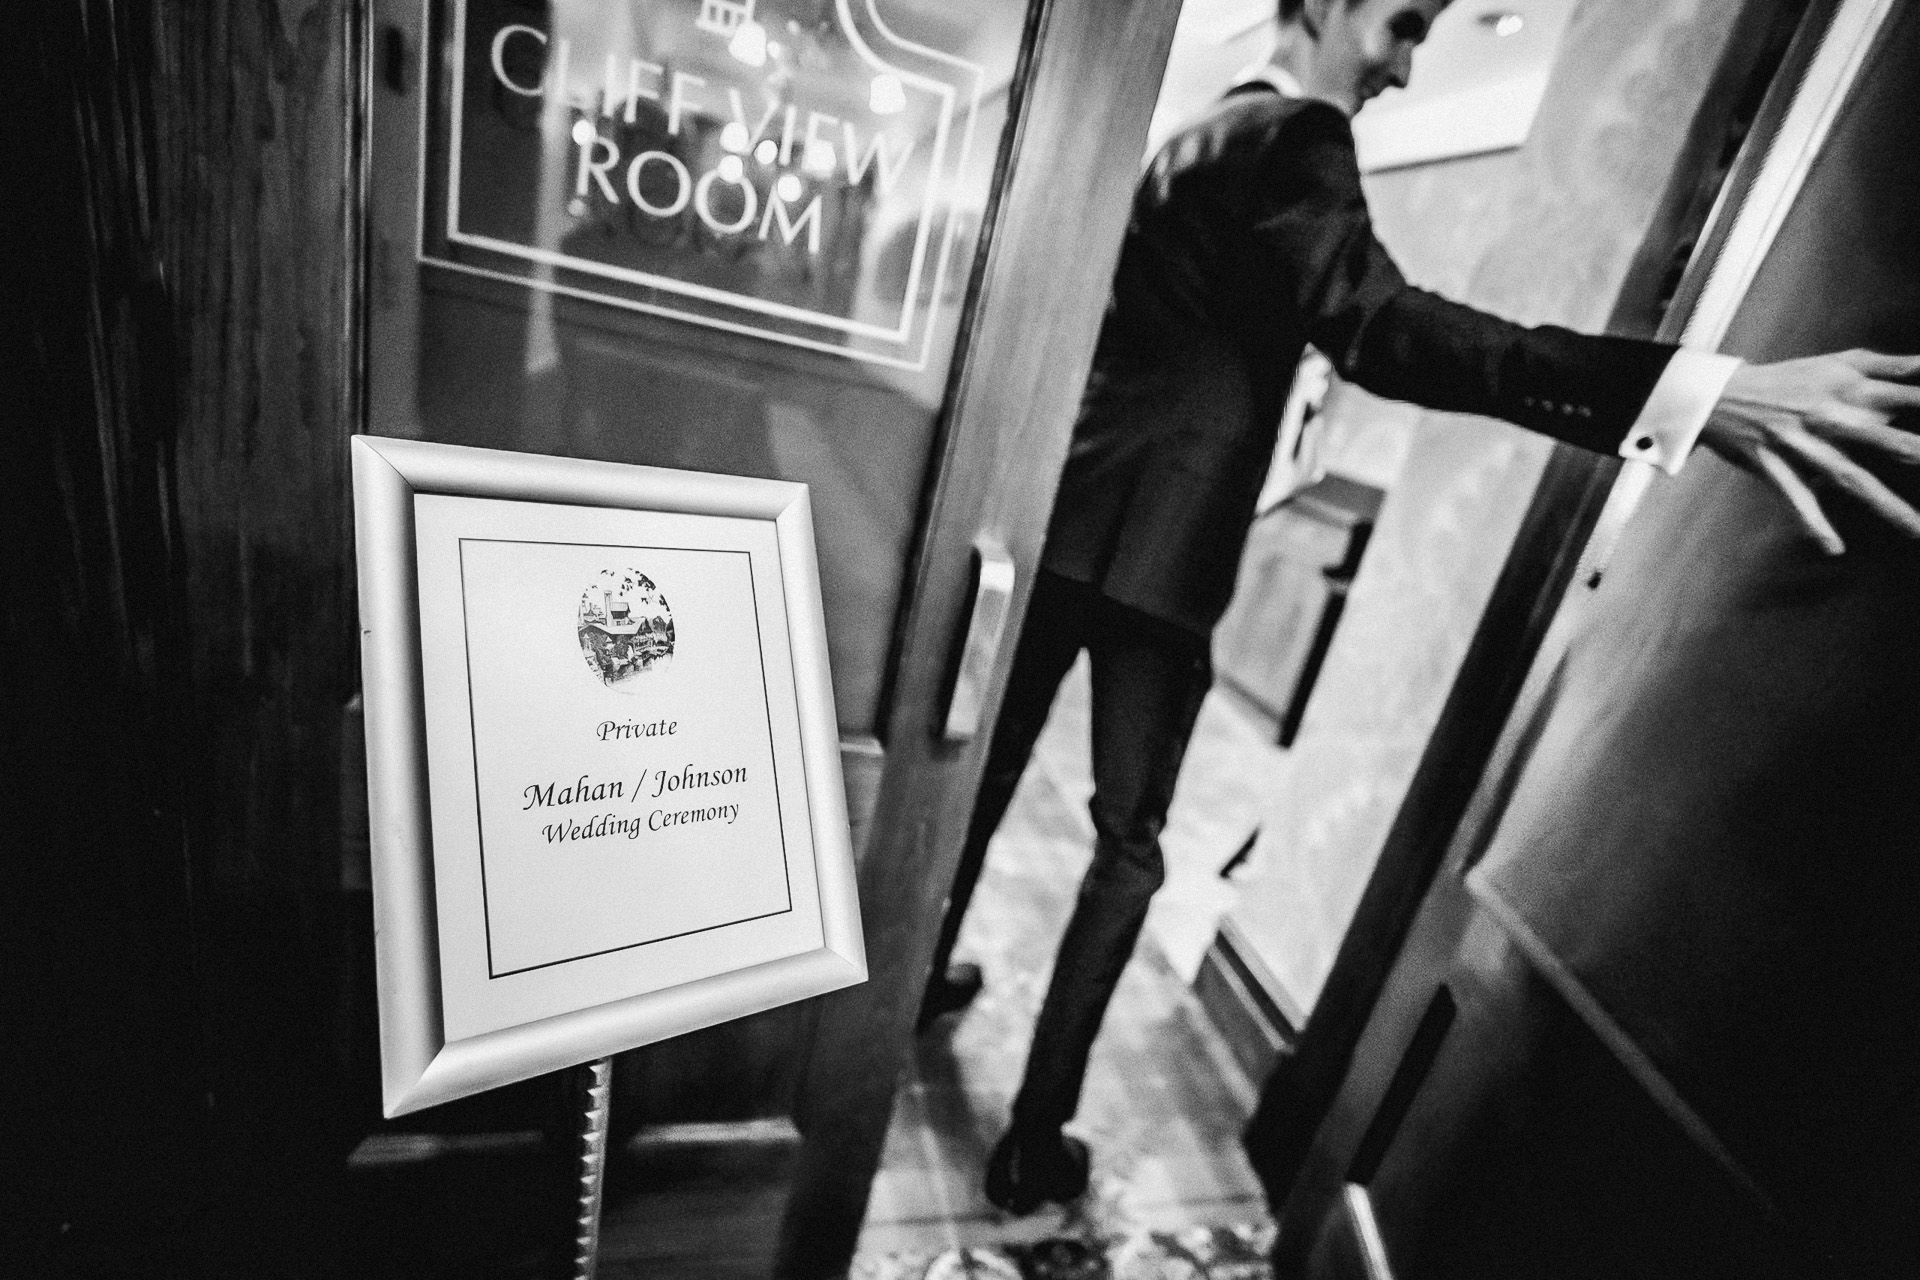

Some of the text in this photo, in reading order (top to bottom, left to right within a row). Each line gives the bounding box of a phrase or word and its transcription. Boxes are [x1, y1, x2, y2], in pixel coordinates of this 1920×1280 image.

[491, 24, 916, 197] CLIFF VIEW
[575, 135, 823, 254] ROOM
[596, 718, 678, 741] Private
[523, 764, 748, 810] Mahan / Johnson
[541, 803, 739, 844] Wedding Ceremony
